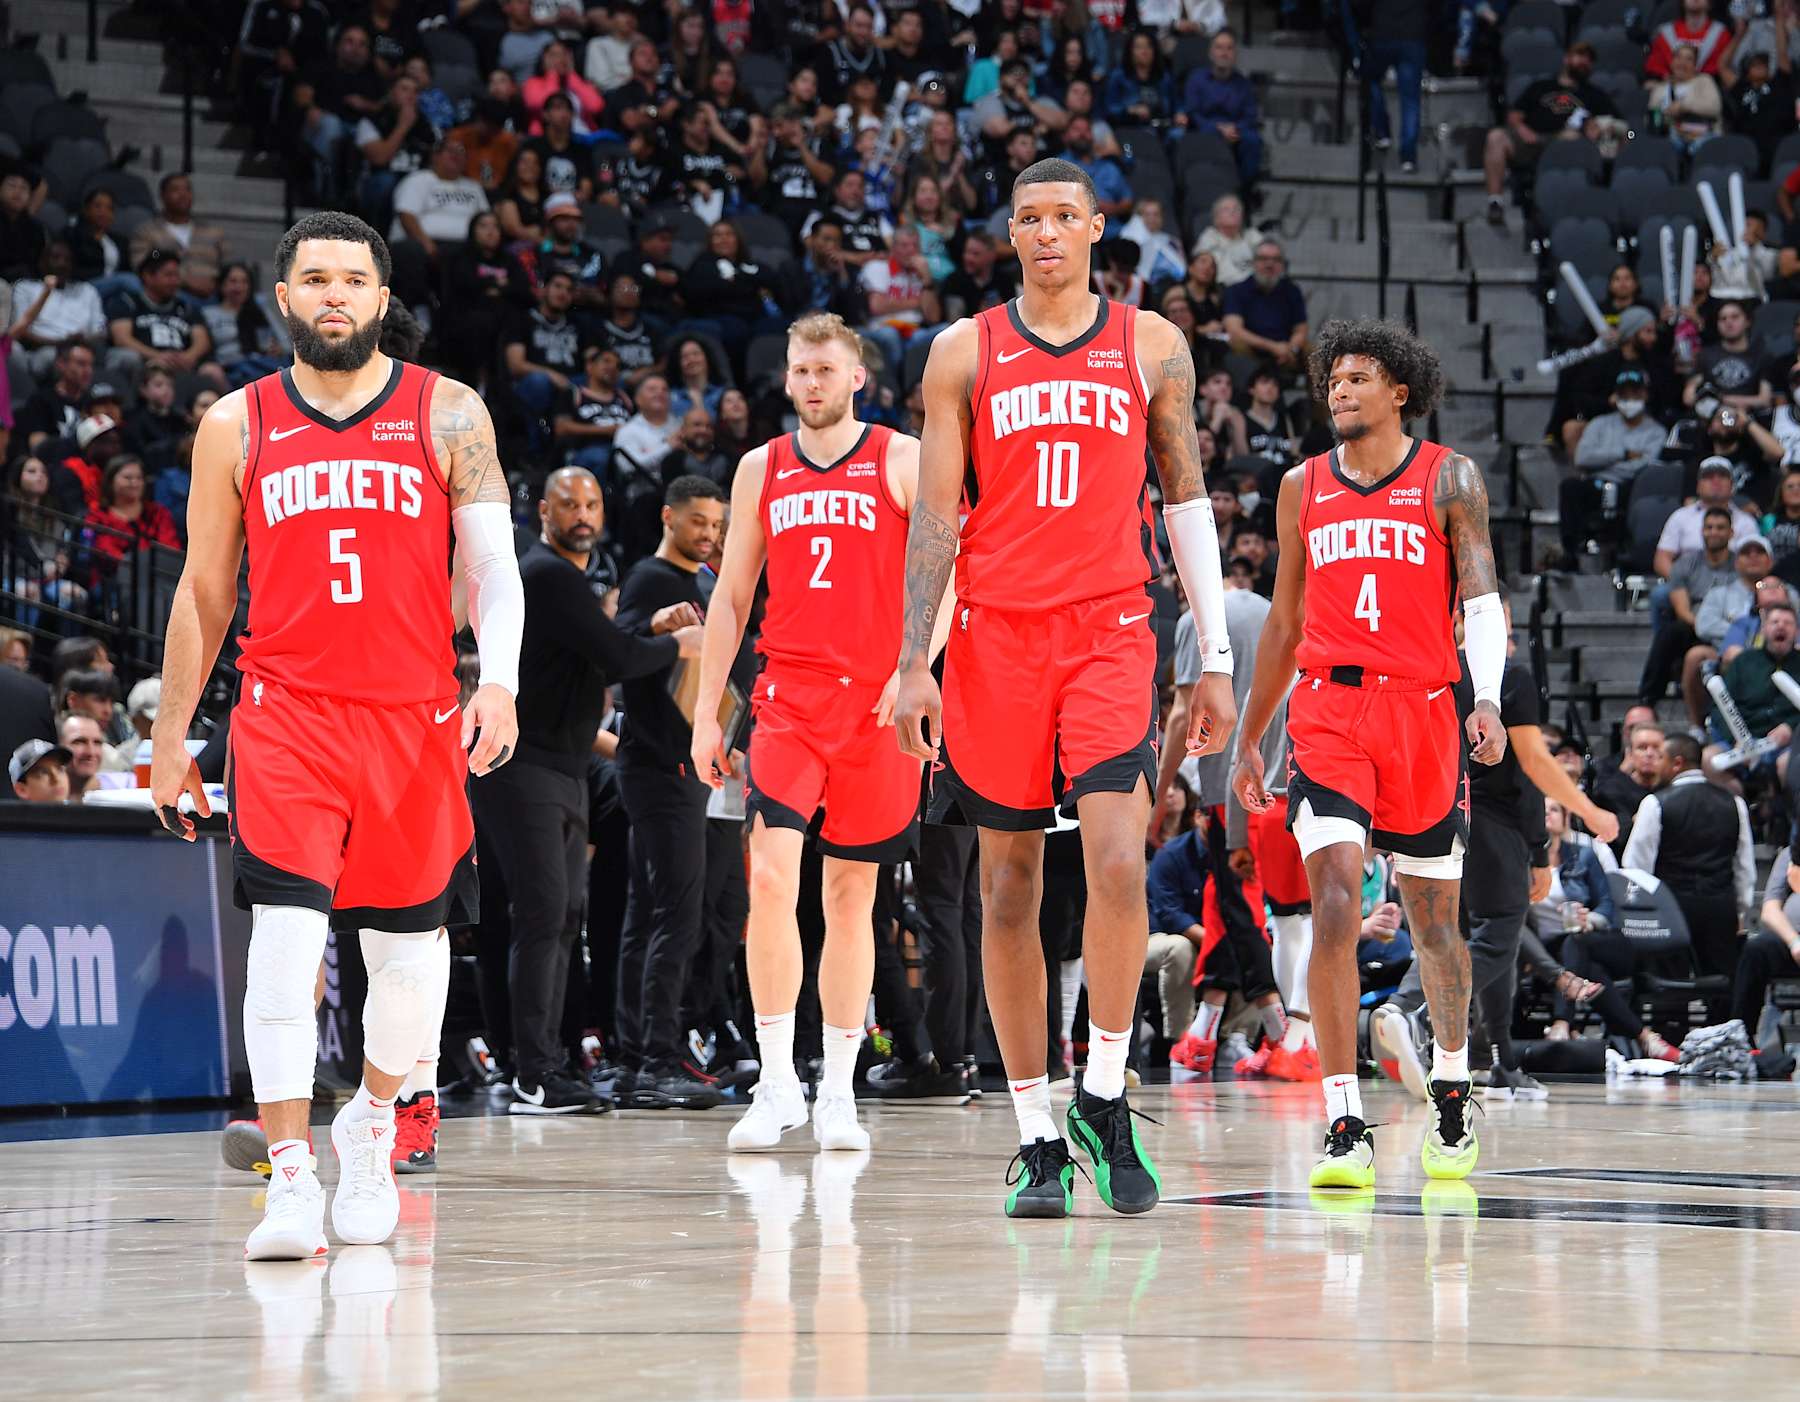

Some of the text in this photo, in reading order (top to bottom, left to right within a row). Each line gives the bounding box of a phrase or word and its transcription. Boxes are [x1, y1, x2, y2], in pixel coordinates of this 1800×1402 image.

[1087, 358, 1124, 369] karma
[1088, 349, 1123, 359] credit
[374, 419, 415, 430] credit
[990, 380, 1130, 441] ROCKETS
[372, 430, 415, 441] karma
[846, 469, 877, 477] karma
[848, 461, 876, 470] credit
[1035, 441, 1080, 508] 10
[260, 459, 423, 529] ROCKETS
[1388, 496, 1422, 506] karma
[1390, 487, 1422, 497] credit
[769, 489, 877, 537] ROCKETS
[1308, 518, 1427, 570] ROCKETS
[328, 527, 364, 604] 5
[808, 536, 833, 589] 2
[1354, 573, 1382, 632] 4
